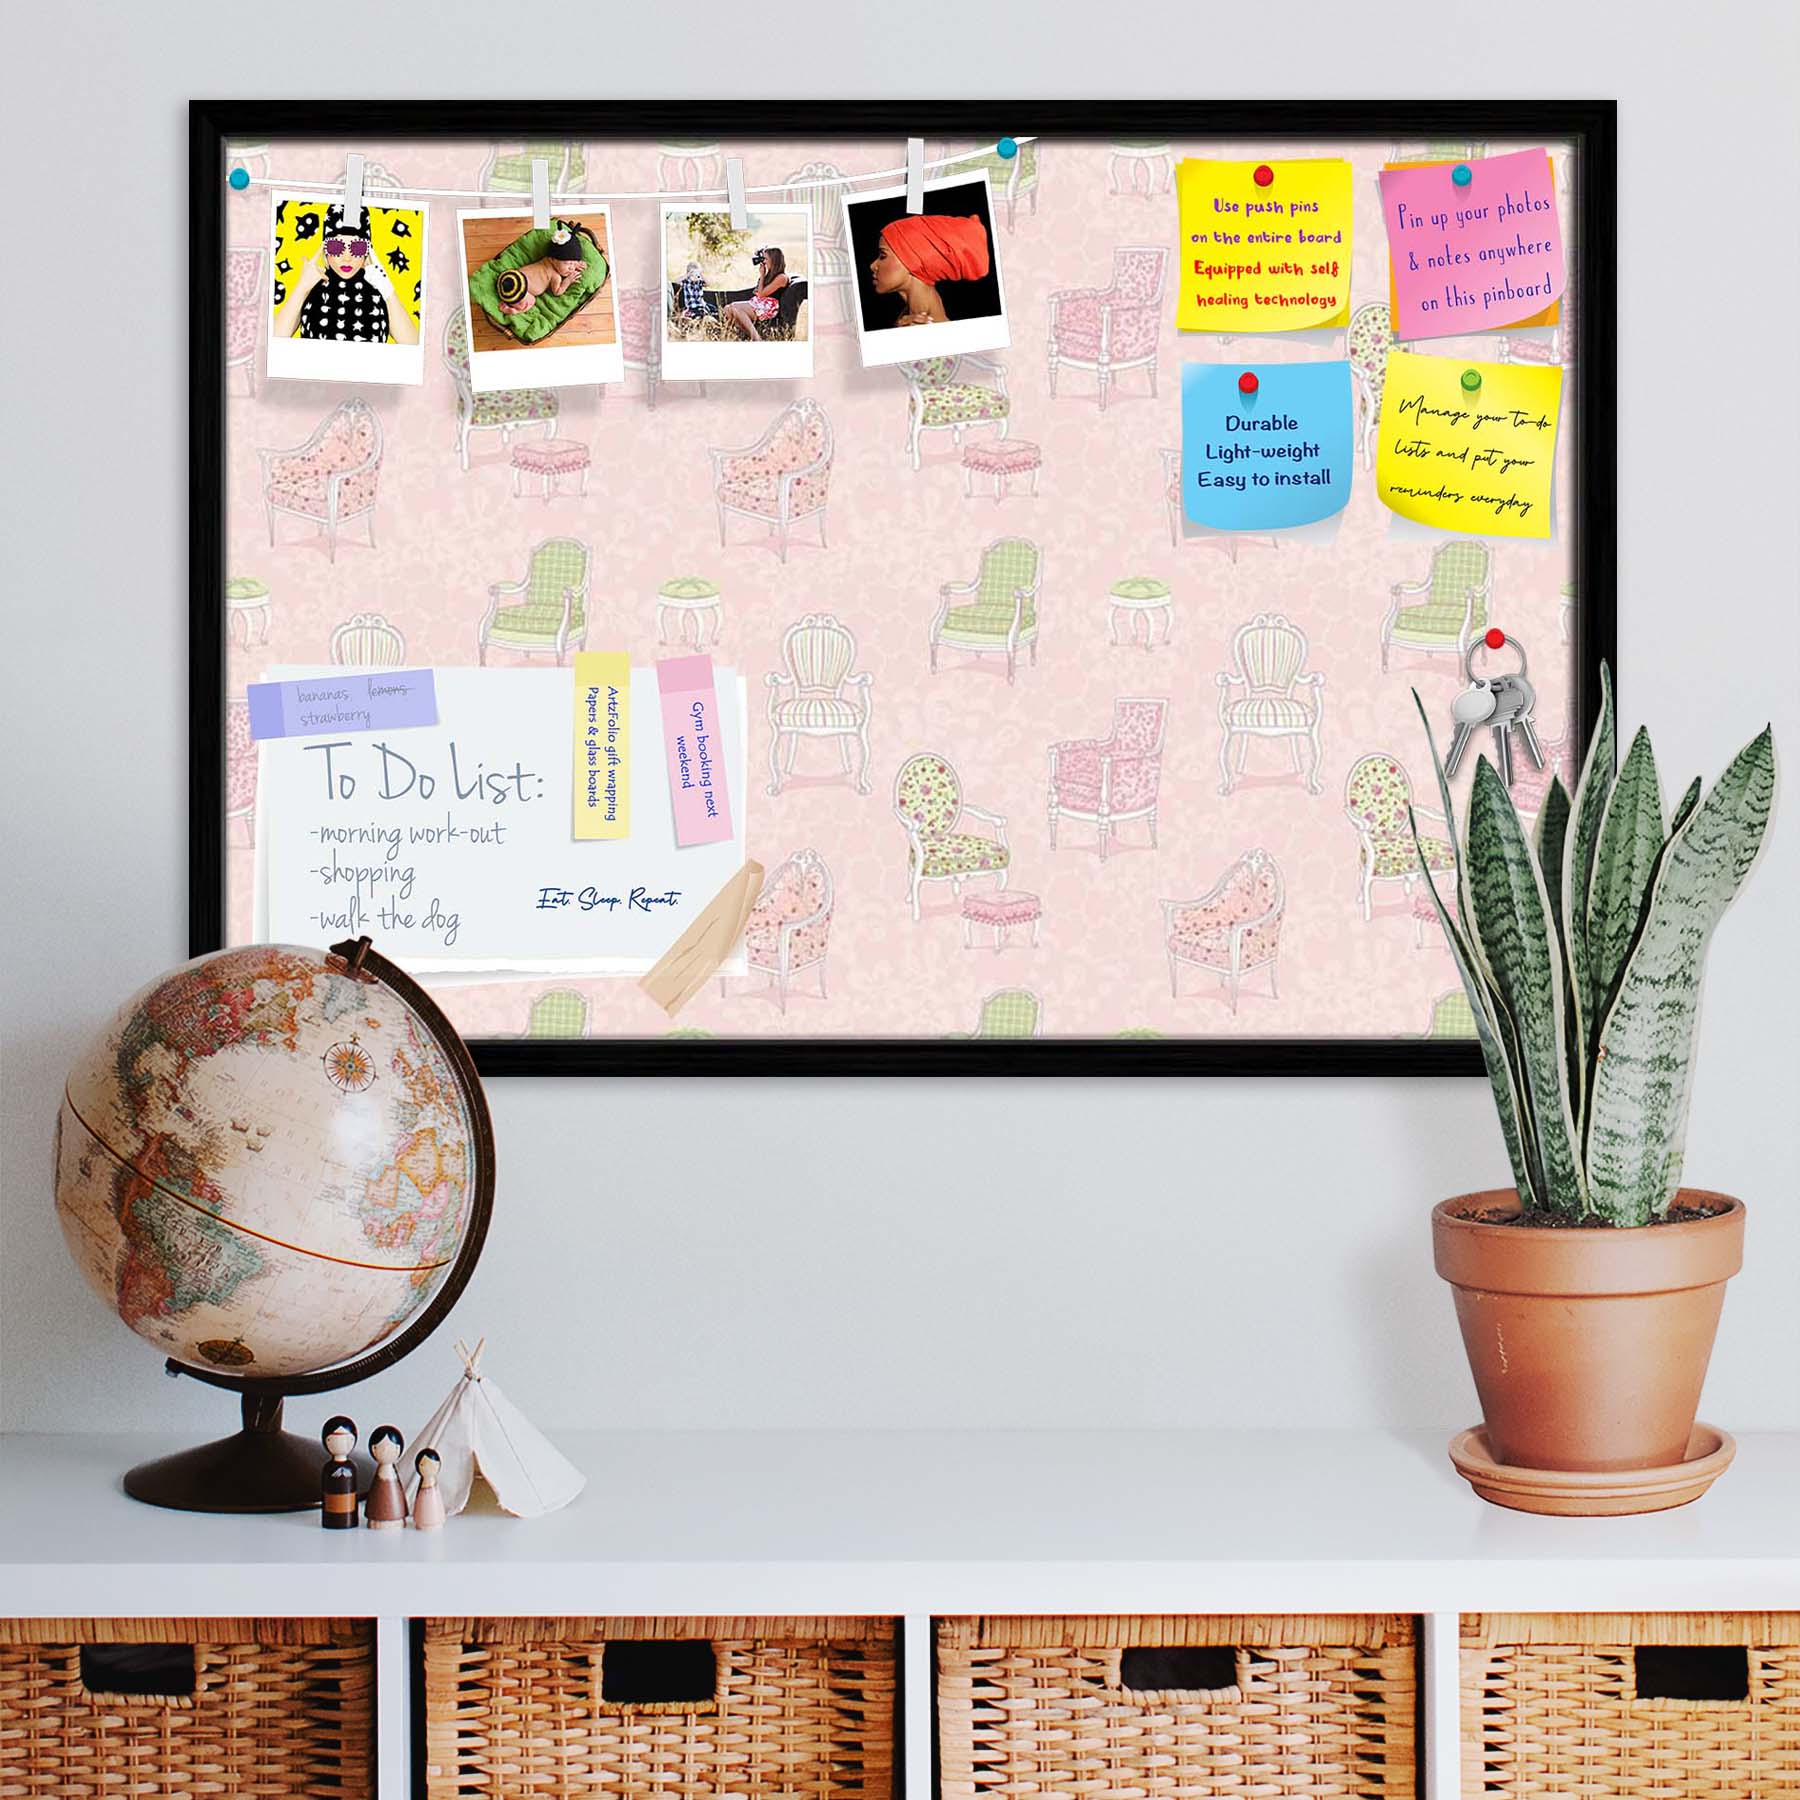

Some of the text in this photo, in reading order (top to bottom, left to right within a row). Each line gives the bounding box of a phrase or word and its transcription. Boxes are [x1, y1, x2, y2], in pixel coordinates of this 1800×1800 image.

[1214, 198, 1318, 218] Use push pins
[1398, 190, 1550, 231] Pin up your photos
[1191, 229, 1342, 244] on the entire board
[1409, 233, 1552, 271] & notes anywhere
[1194, 260, 1339, 280] Equipped with self
[1197, 293, 1336, 309] healing technology
[1421, 272, 1552, 311] on this pinboard
[1226, 414, 1298, 432] Durable
[1399, 395, 1470, 426] Manage
[1472, 412, 1507, 430] your
[1206, 441, 1320, 464] Light-weight
[1436, 447, 1469, 463] and
[1471, 448, 1504, 471] put
[1500, 457, 1535, 474] your
[1198, 468, 1331, 491] Easy to install
[1390, 485, 1533, 518] reminders everyday
[300, 704, 371, 728] strawberry
[585, 687, 600, 808] Papers & glass boards
[604, 686, 621, 821] ArtzFolio gift wrapping
[677, 735, 695, 789] weekend
[690, 701, 718, 818] Gym booking next
[304, 741, 543, 804] To Do List:
[410, 811, 507, 844] work-out
[377, 894, 416, 929] the
[421, 898, 461, 946] dog
